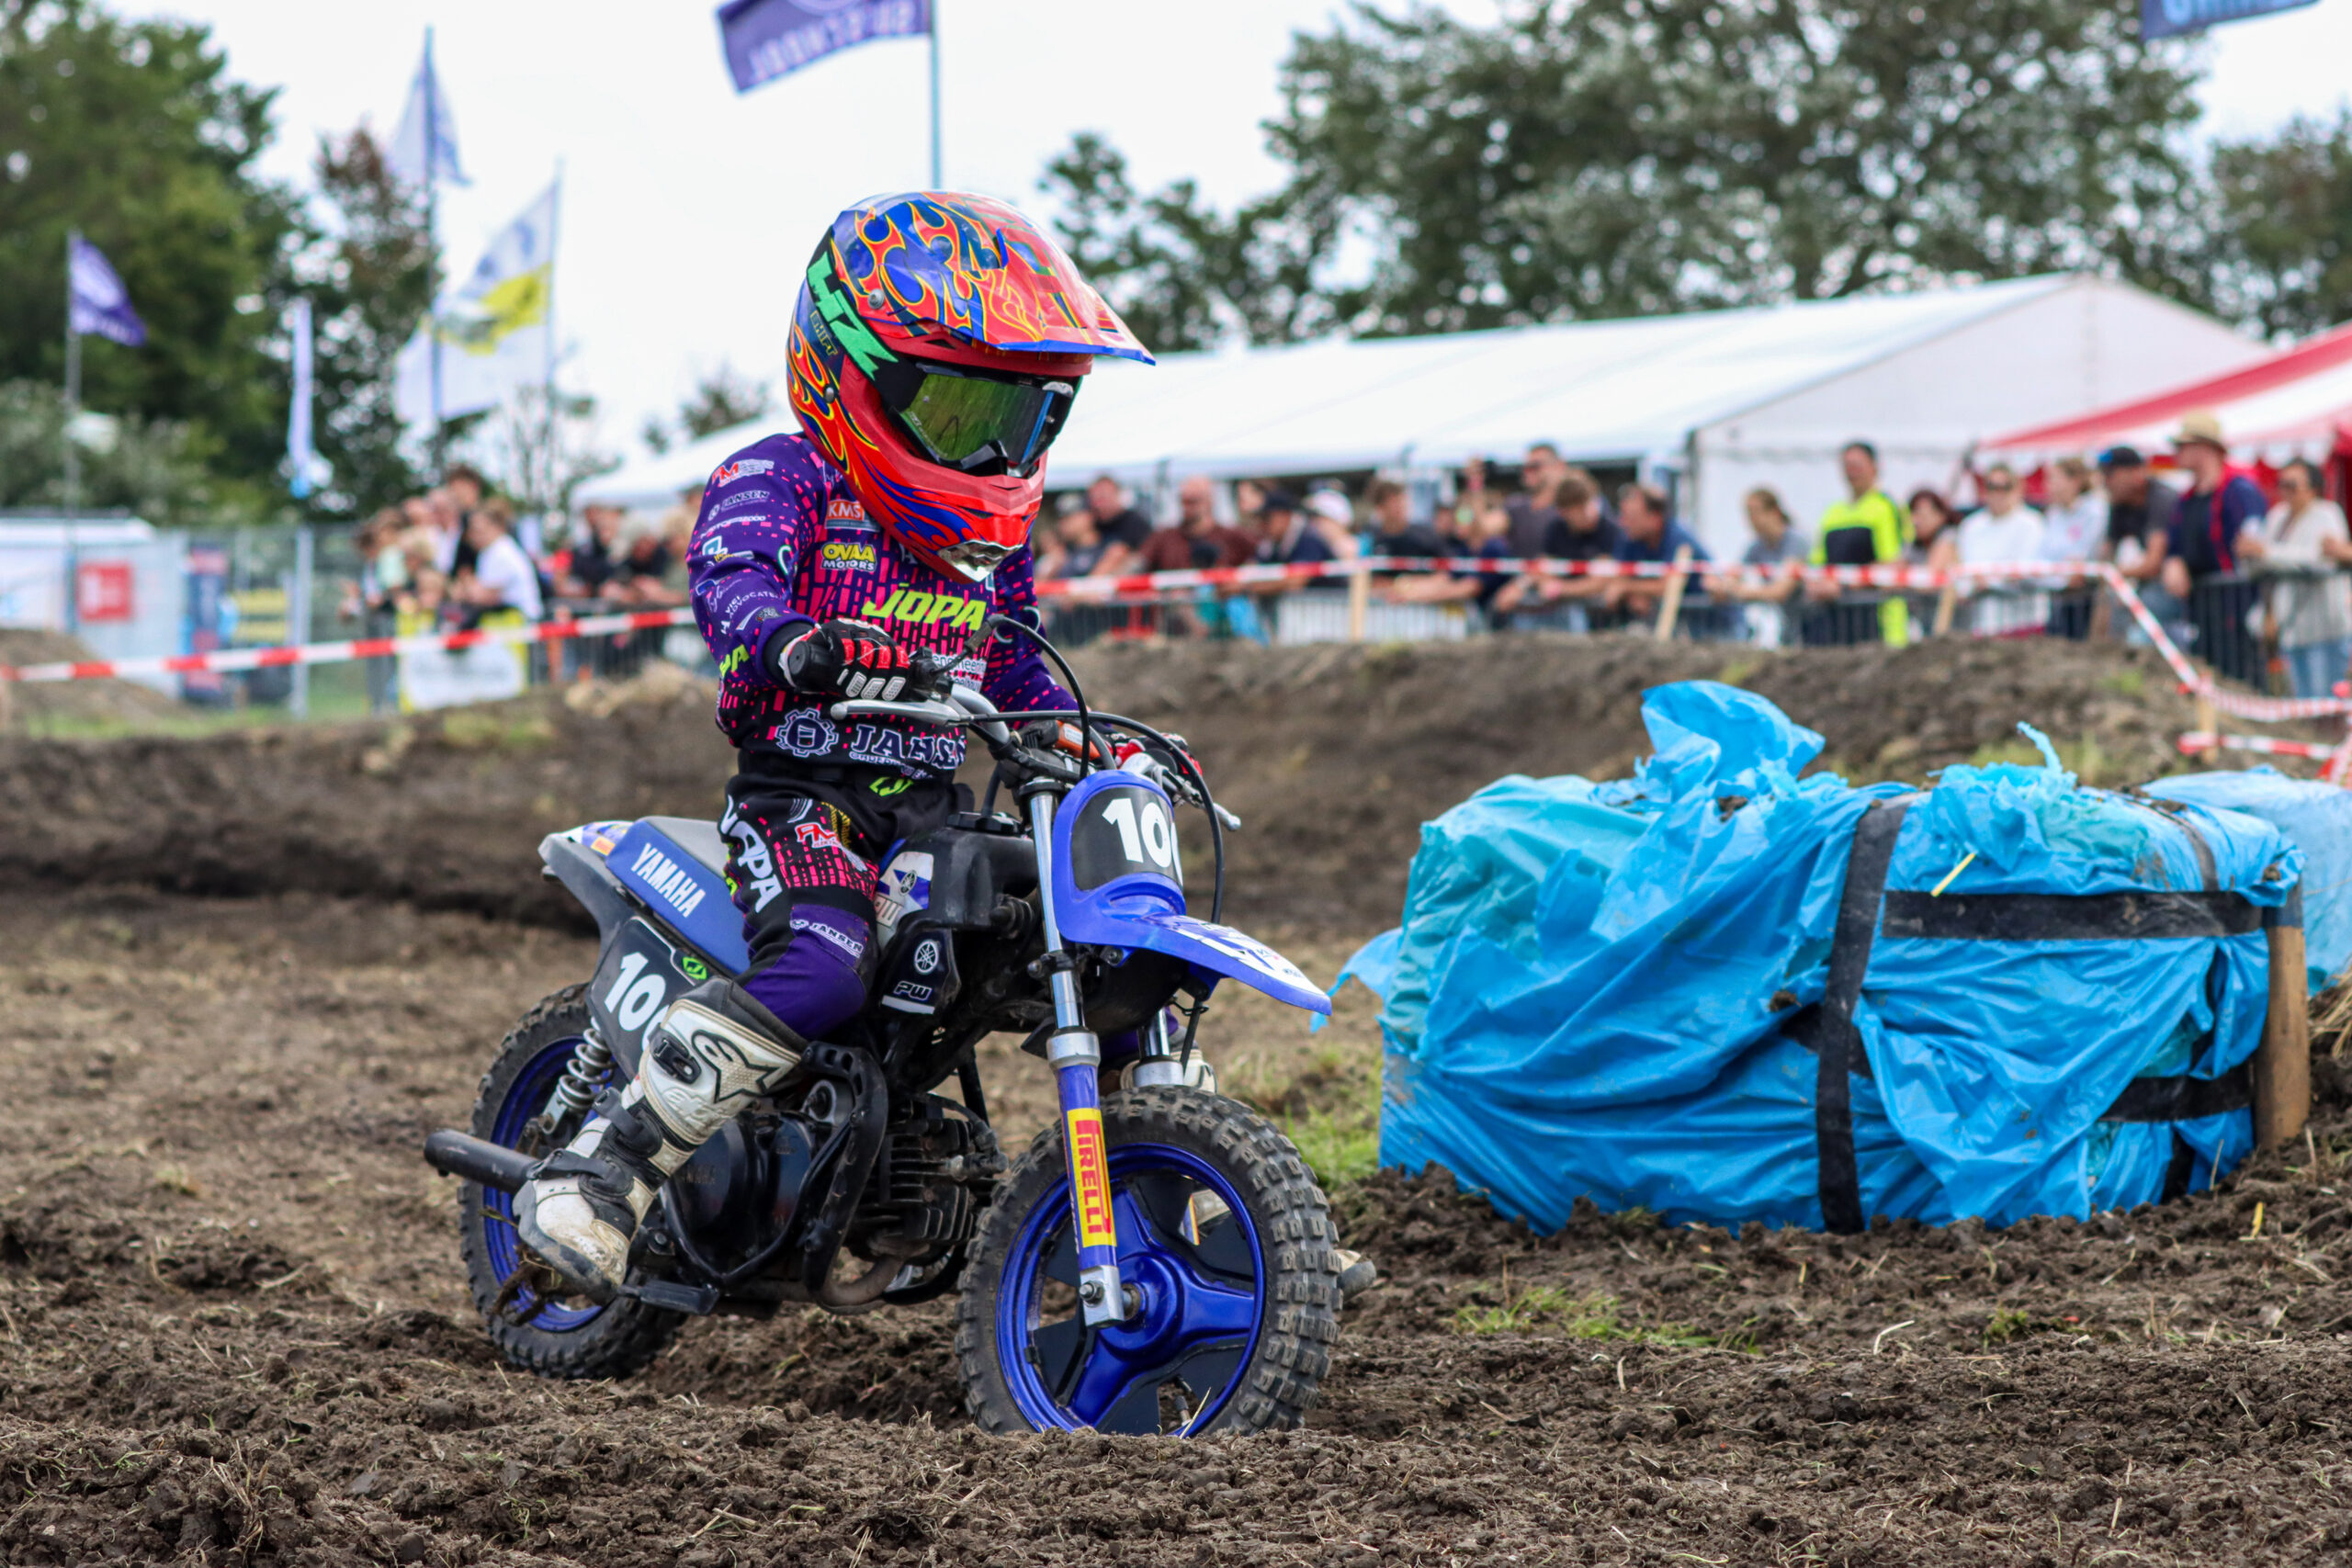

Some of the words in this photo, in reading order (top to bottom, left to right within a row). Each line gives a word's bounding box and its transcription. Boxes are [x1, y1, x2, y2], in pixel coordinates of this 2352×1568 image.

[829, 502, 862, 519] KMS
[822, 543, 876, 563] OVAA
[861, 583, 987, 631] JOPA
[630, 841, 706, 918] YAMAHA
[810, 922, 864, 953] JANSEN
[893, 980, 933, 1001] PW
[1075, 1120, 1112, 1235] PIRELLI
